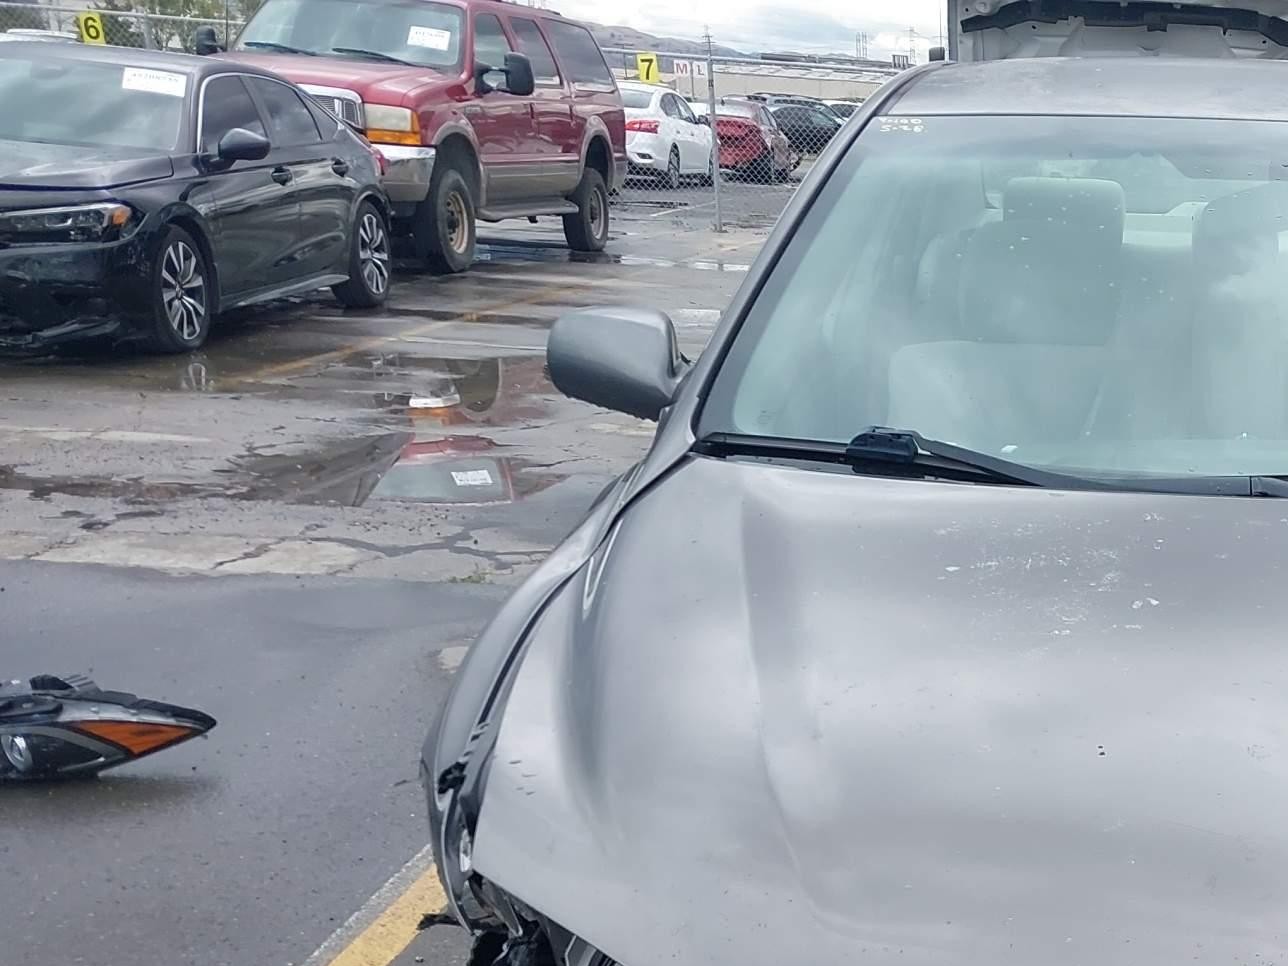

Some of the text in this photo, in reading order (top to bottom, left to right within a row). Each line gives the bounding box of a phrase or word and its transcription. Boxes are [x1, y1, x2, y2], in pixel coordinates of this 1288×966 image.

[84, 16, 100, 40] 6
[640, 58, 654, 80] 7
[675, 63, 688, 75] M
[697, 64, 705, 76] L
